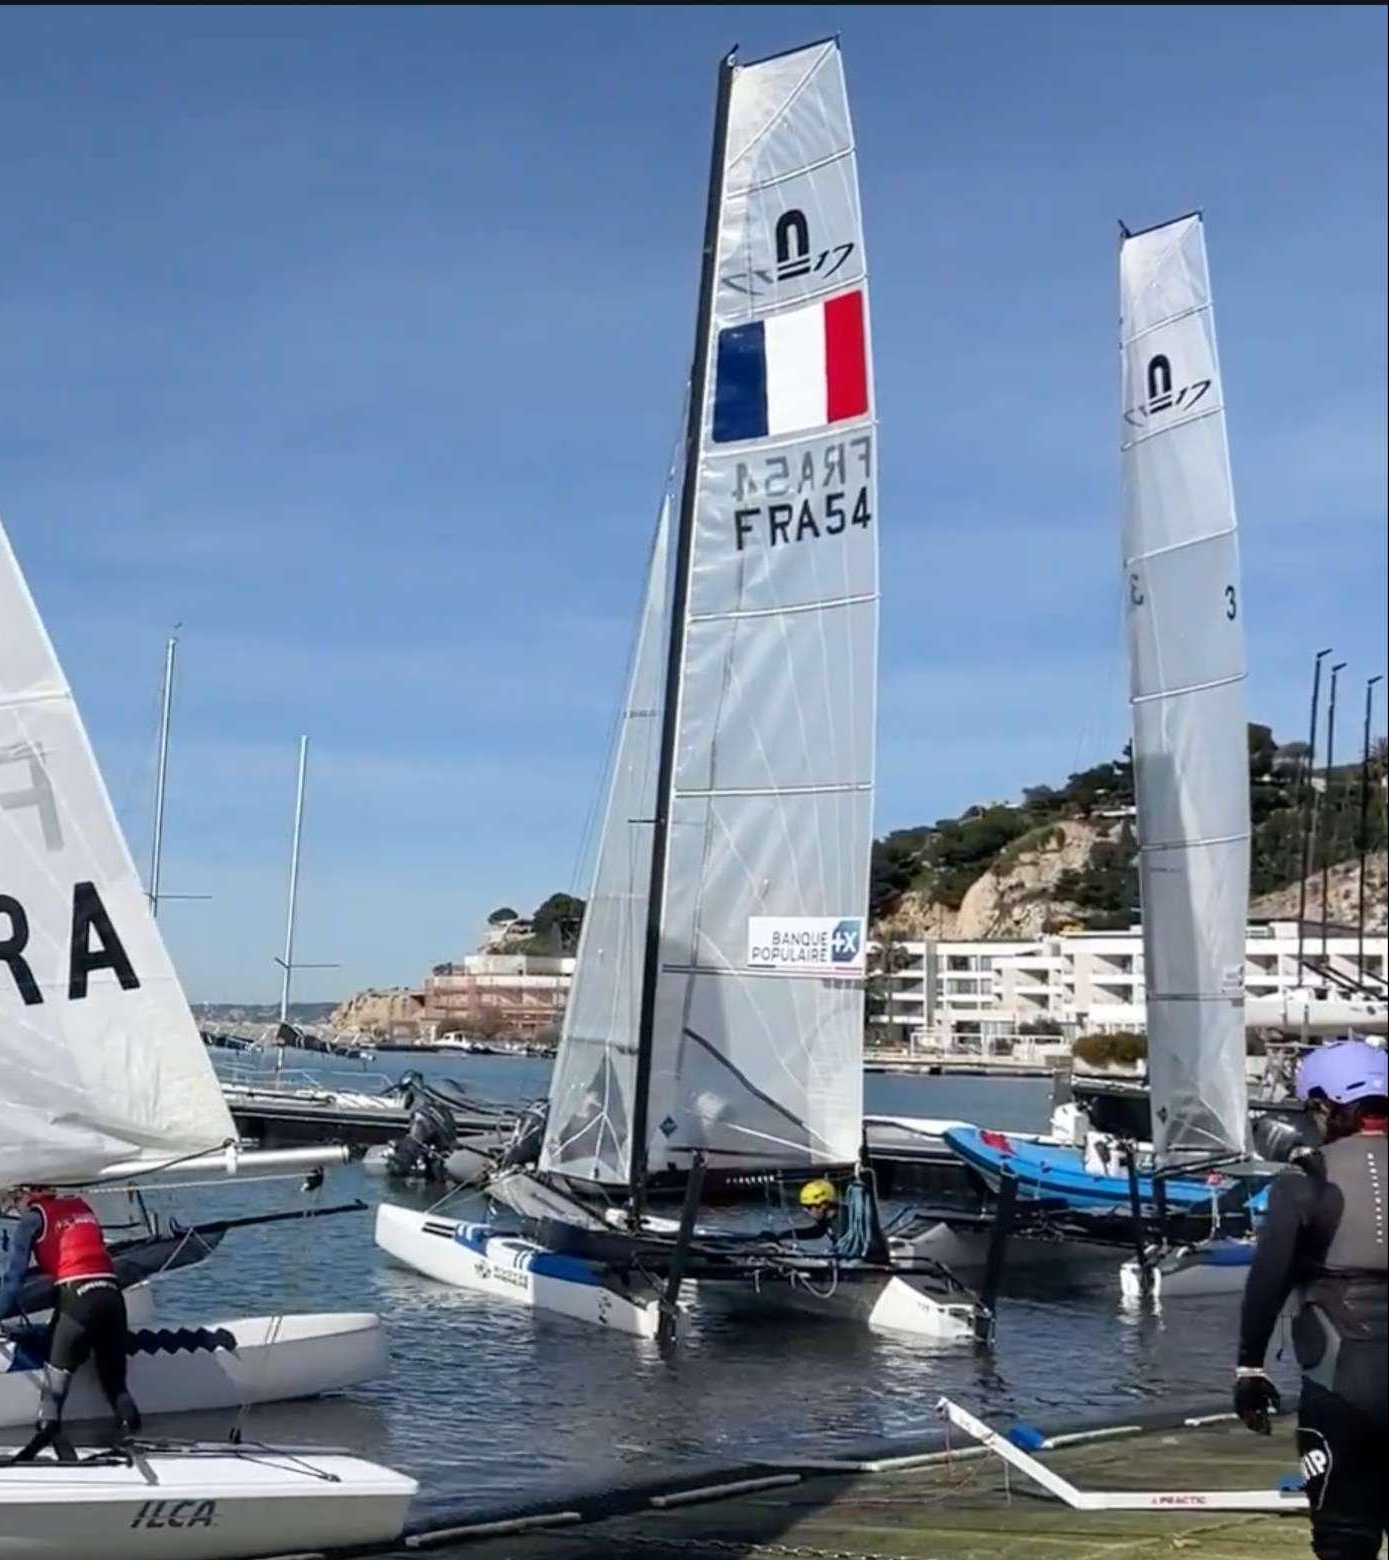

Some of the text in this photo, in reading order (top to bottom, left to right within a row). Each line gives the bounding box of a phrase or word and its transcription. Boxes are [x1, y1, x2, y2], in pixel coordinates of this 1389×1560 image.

[734, 486, 873, 551] FRA54
[1224, 585, 1238, 621] 3
[772, 930, 827, 947] BANQUE
[751, 946, 828, 963] POPULAIRE
[130, 1499, 217, 1529] ILCA
